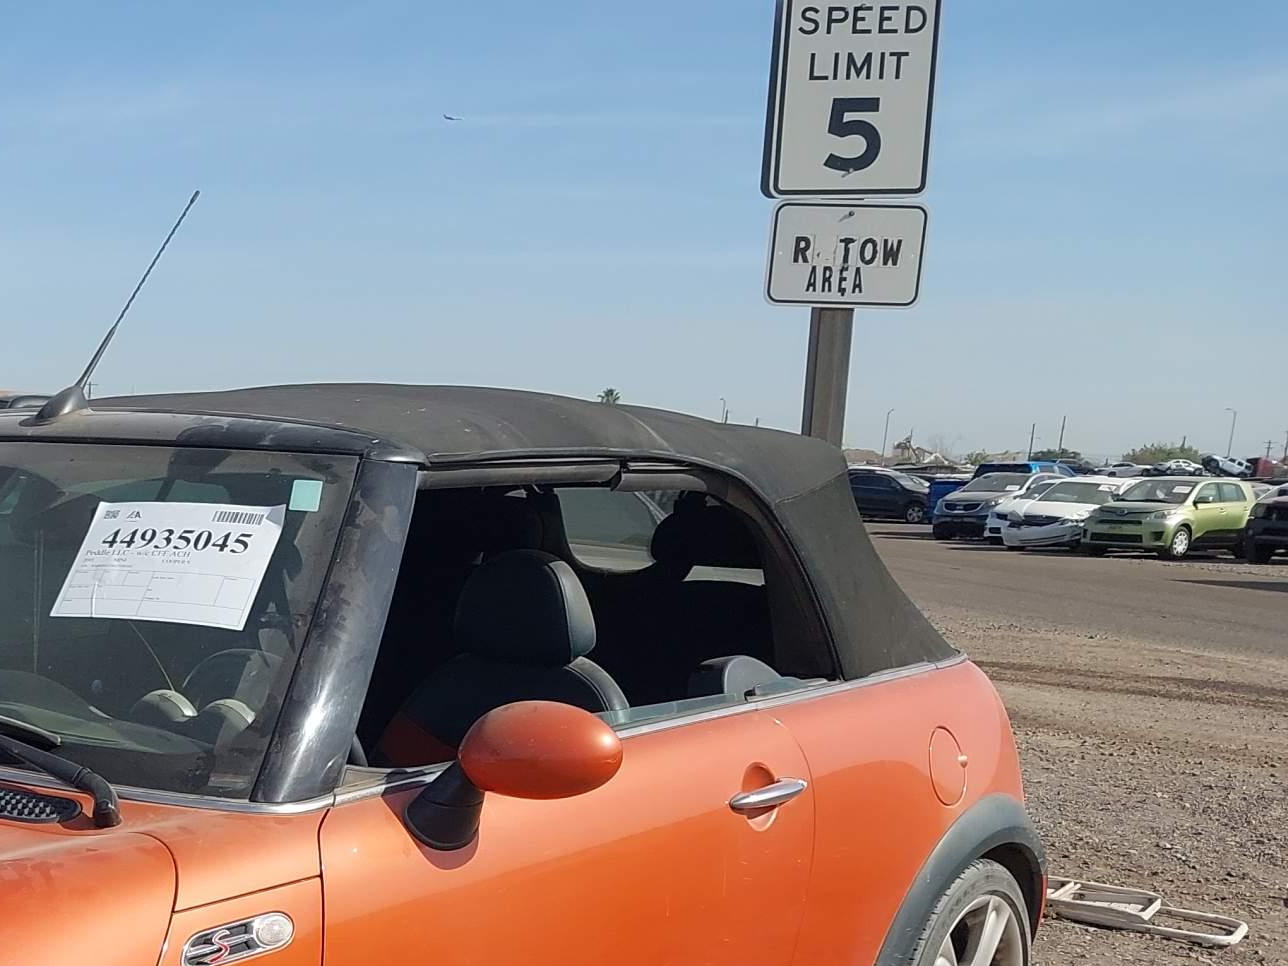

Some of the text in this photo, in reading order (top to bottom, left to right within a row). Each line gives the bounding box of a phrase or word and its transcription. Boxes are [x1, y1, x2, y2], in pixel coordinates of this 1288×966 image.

[798, 5, 928, 35] SPEED
[808, 51, 910, 81] LIMIT
[823, 97, 882, 173] 5
[838, 237, 903, 267] TOW
[805, 265, 863, 294] AREA
[101, 527, 254, 555] 44935045
